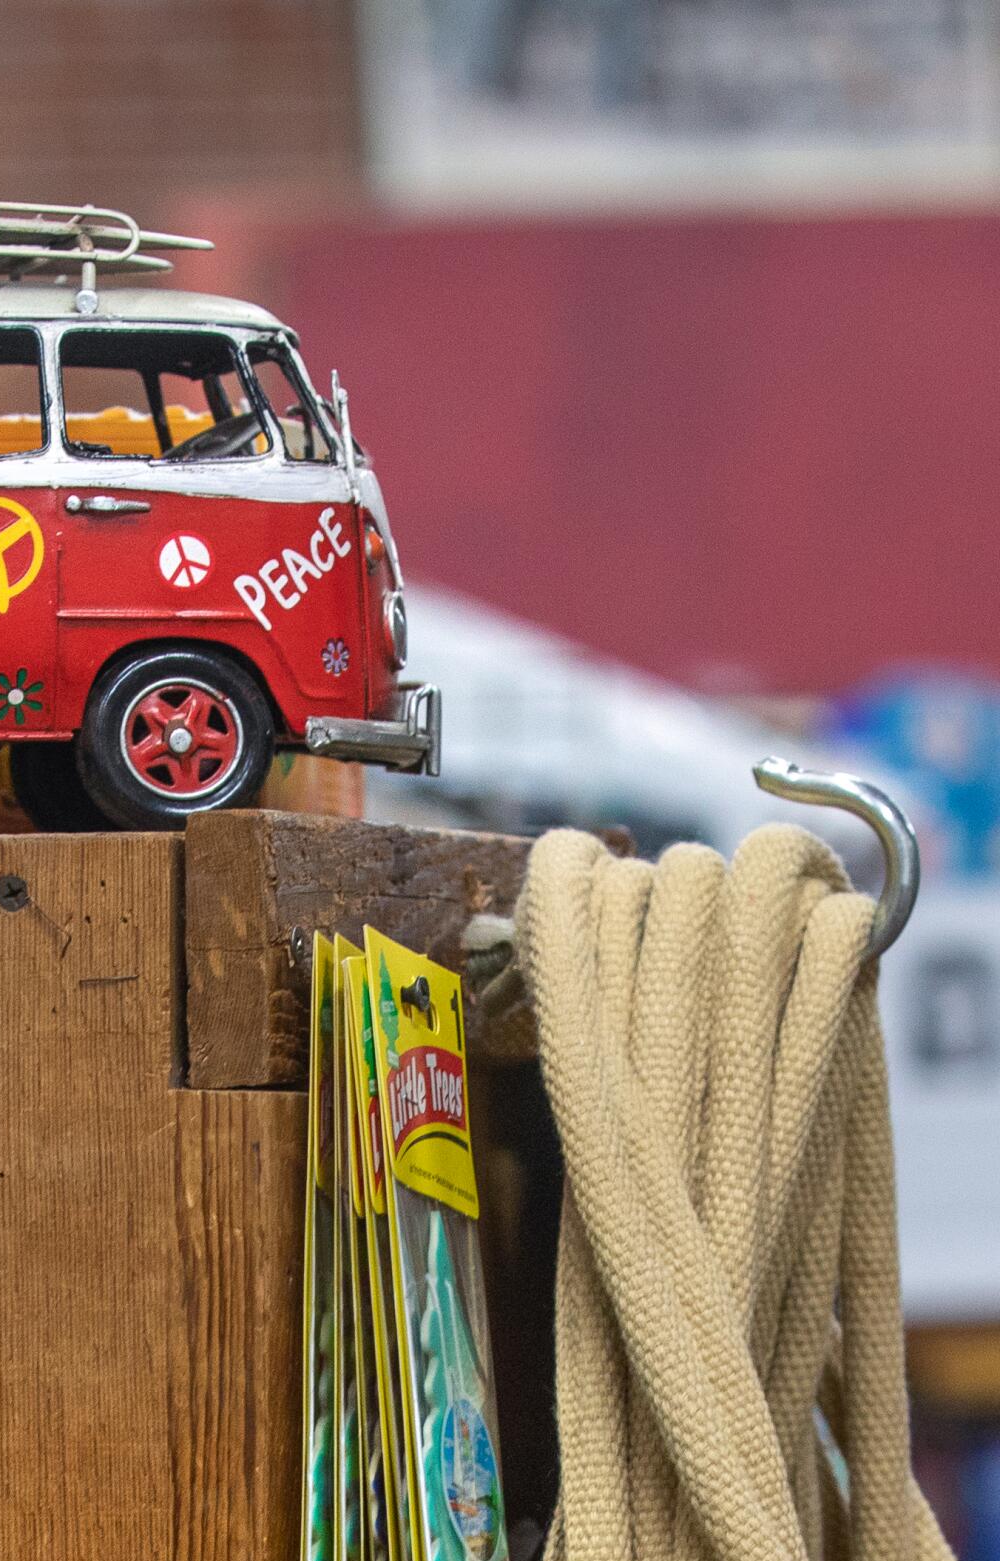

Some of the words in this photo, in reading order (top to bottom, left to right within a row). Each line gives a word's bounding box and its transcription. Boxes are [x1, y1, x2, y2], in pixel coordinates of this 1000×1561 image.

[233, 507, 352, 631] PEACE
[390, 1055, 427, 1141] Little
[425, 1052, 463, 1118] Trees
